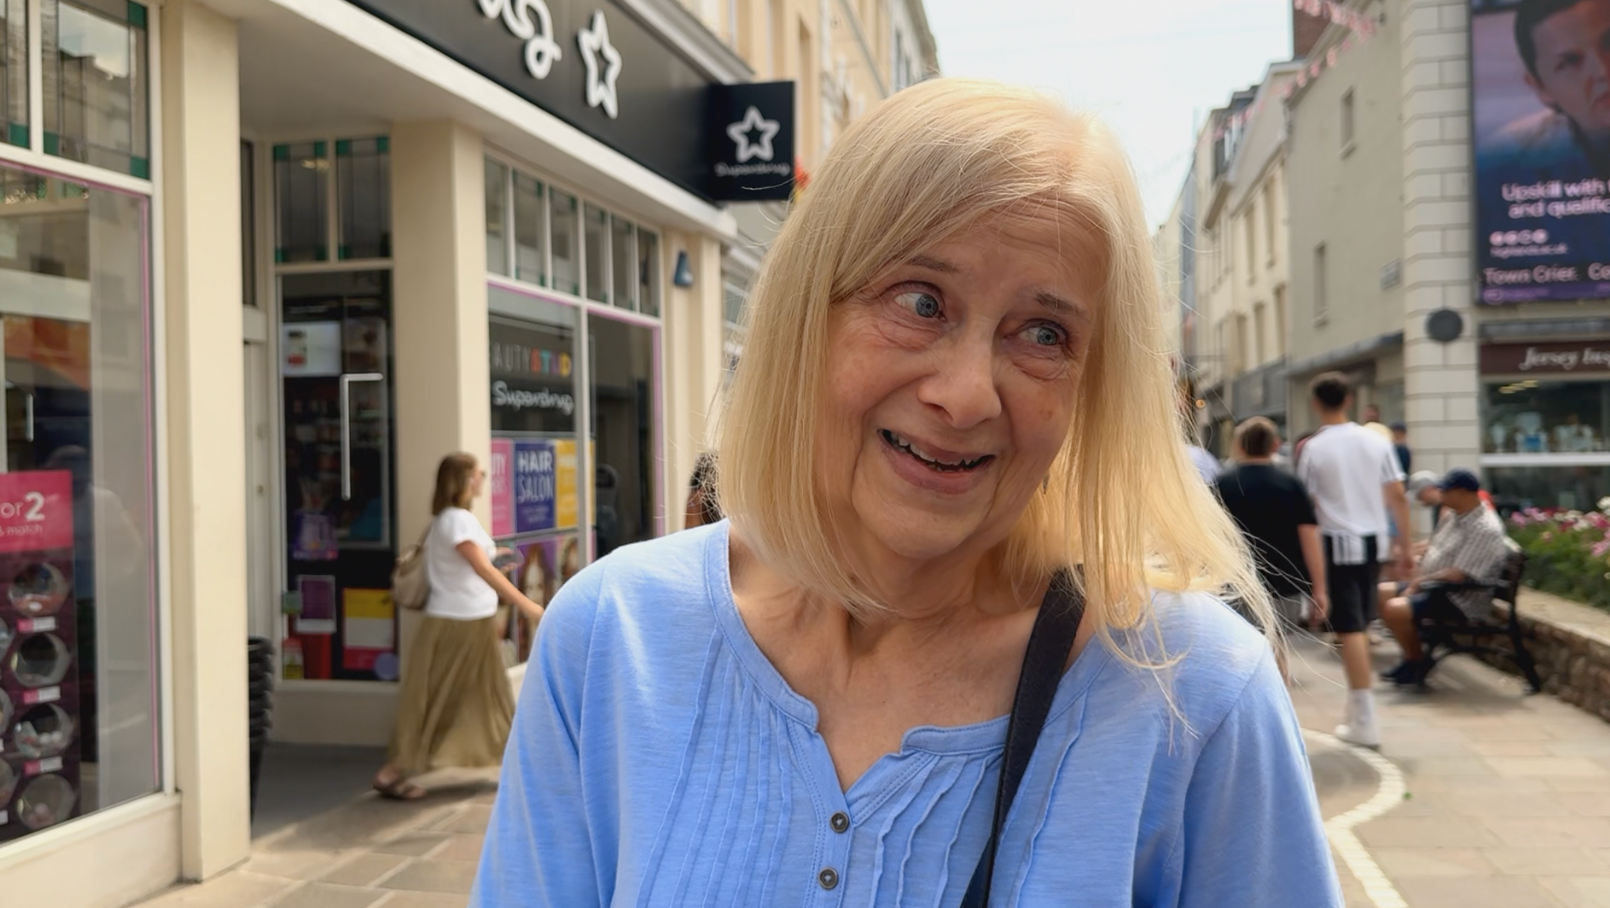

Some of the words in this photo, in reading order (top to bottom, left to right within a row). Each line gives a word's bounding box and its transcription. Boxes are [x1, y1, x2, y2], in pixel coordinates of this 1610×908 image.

[1502, 180, 1562, 202] Upskill
[1564, 178, 1605, 197] with
[1508, 200, 1545, 219] and
[1483, 267, 1531, 285] Town
[1518, 346, 1578, 371] Jersey
[492, 380, 574, 417] Superdrug
[518, 450, 553, 474] HAIR
[518, 474, 554, 502] SALON
[25, 491, 45, 521] 2
